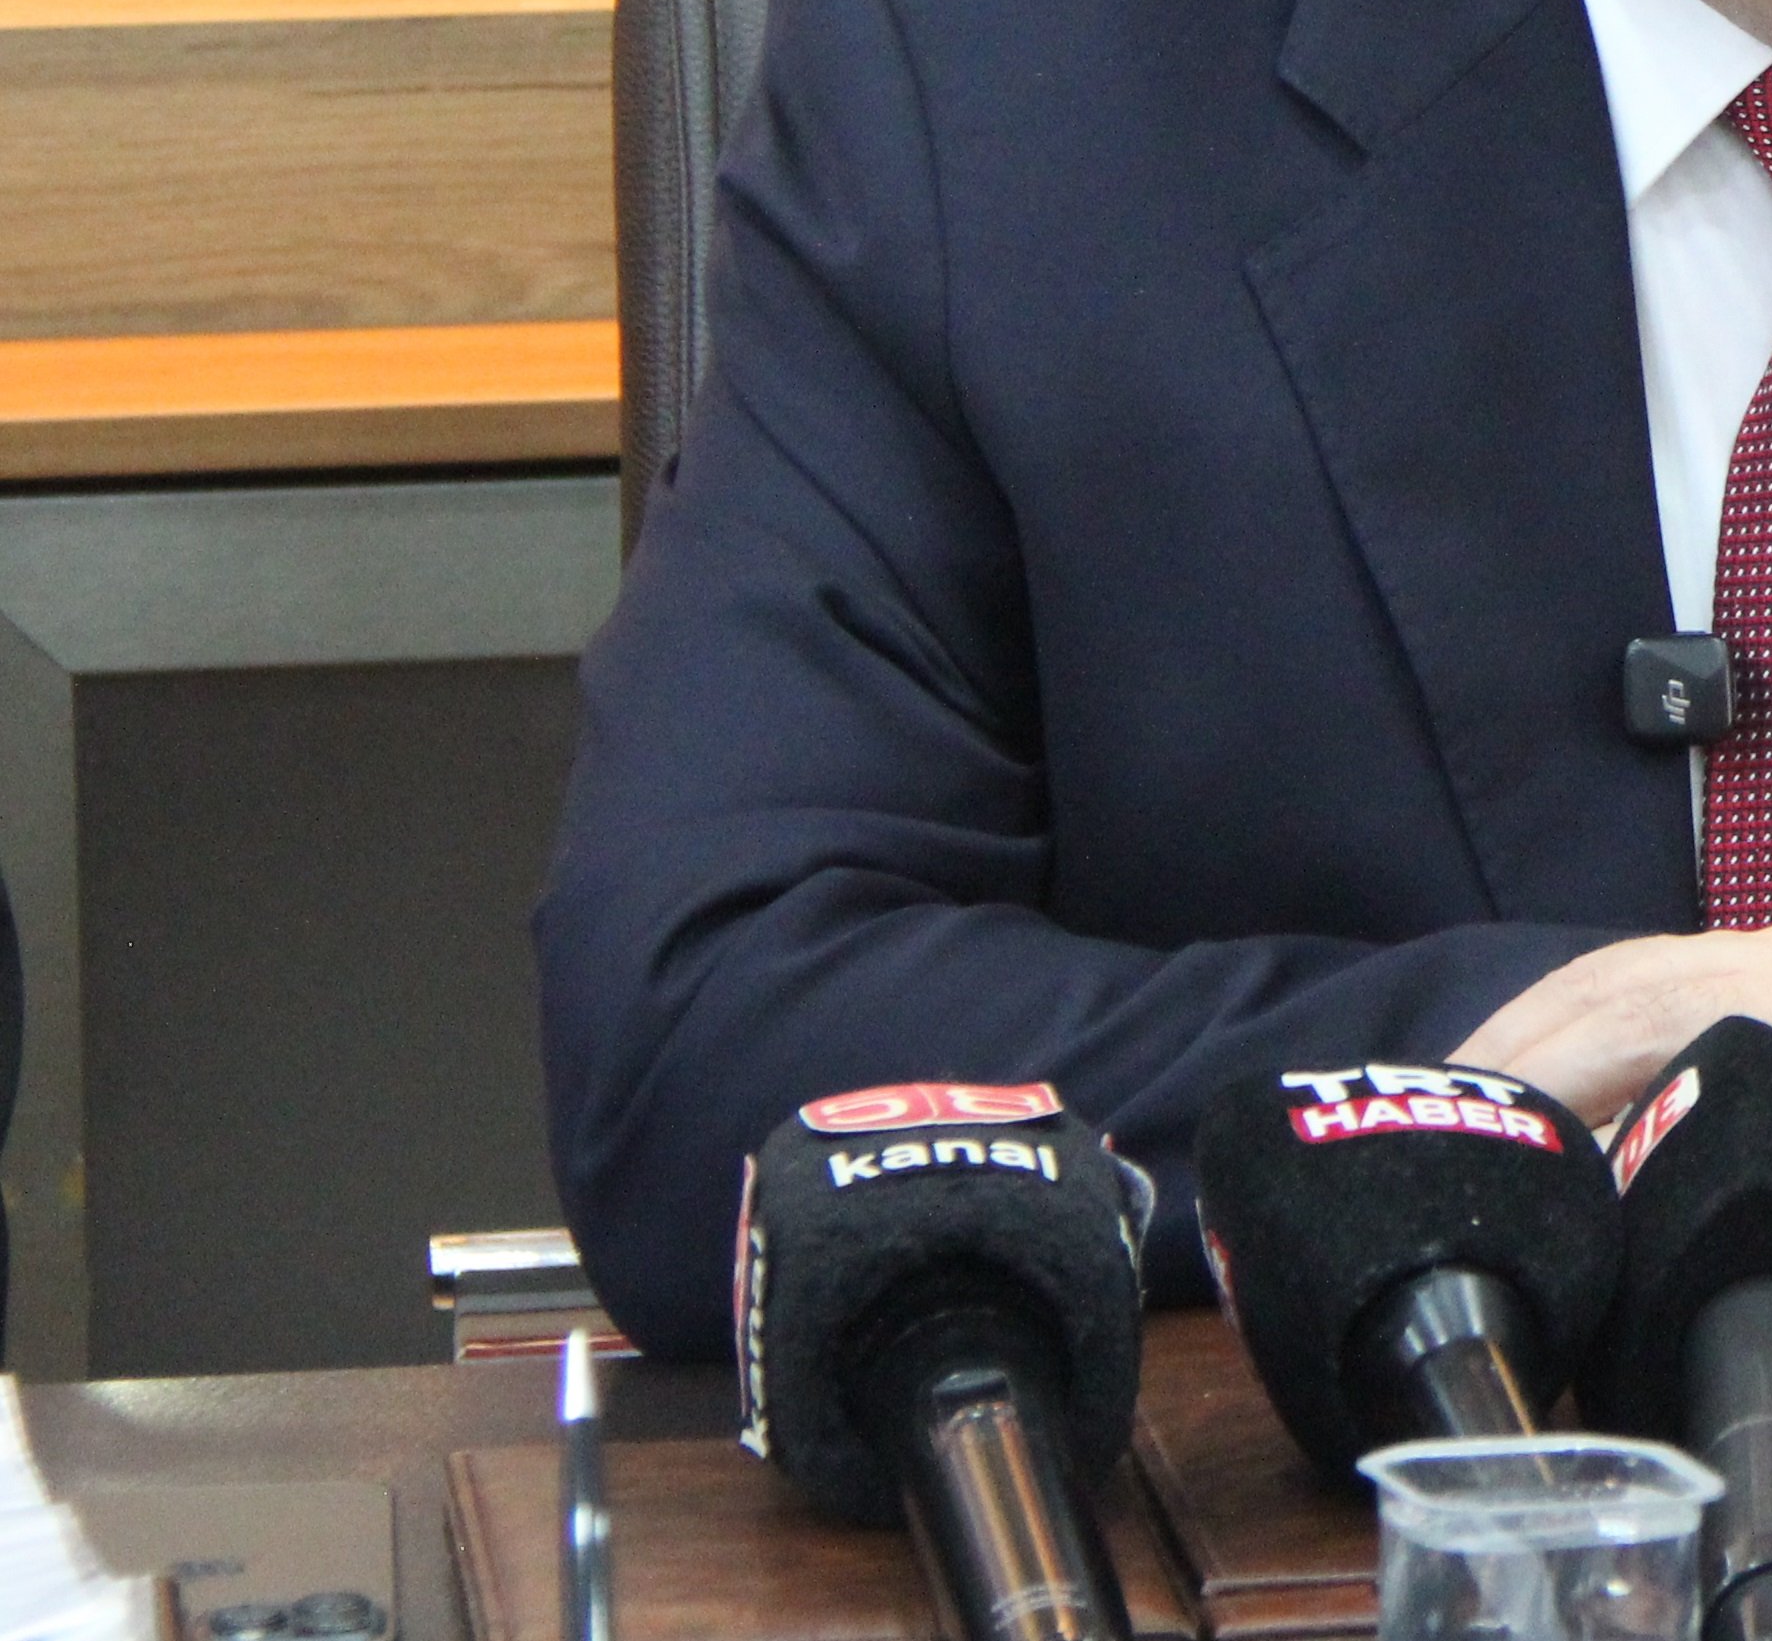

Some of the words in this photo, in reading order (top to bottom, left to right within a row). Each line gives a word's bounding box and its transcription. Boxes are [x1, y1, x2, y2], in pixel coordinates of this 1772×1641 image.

[1281, 1064, 1524, 1105] TRT
[1302, 1097, 1548, 1145] HABER
[828, 1139, 1059, 1188] kanal
